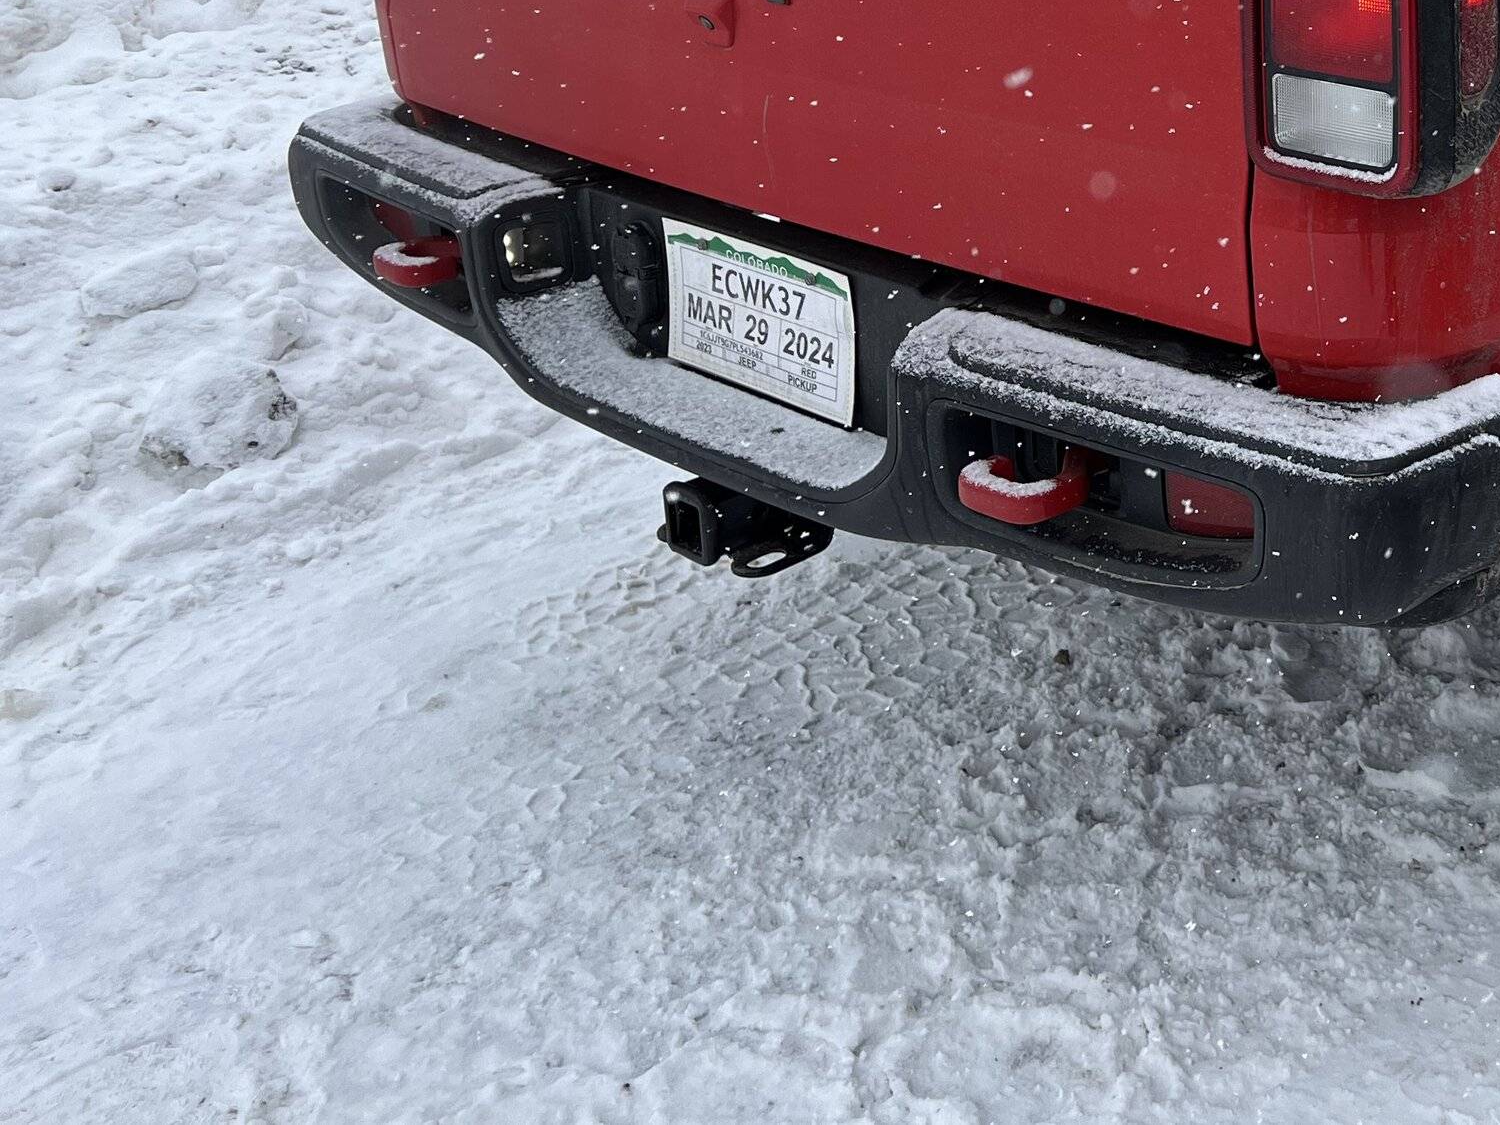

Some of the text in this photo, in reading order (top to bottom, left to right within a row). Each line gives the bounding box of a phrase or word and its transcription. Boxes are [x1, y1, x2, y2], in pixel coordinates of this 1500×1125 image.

[726, 250, 787, 276] COLORADO
[712, 263, 806, 320] ECWK37
[688, 292, 834, 369] MAR 29 2024
[738, 356, 757, 369] JEEP
[788, 375, 818, 393] PICKUP
[801, 368, 817, 380] RED
